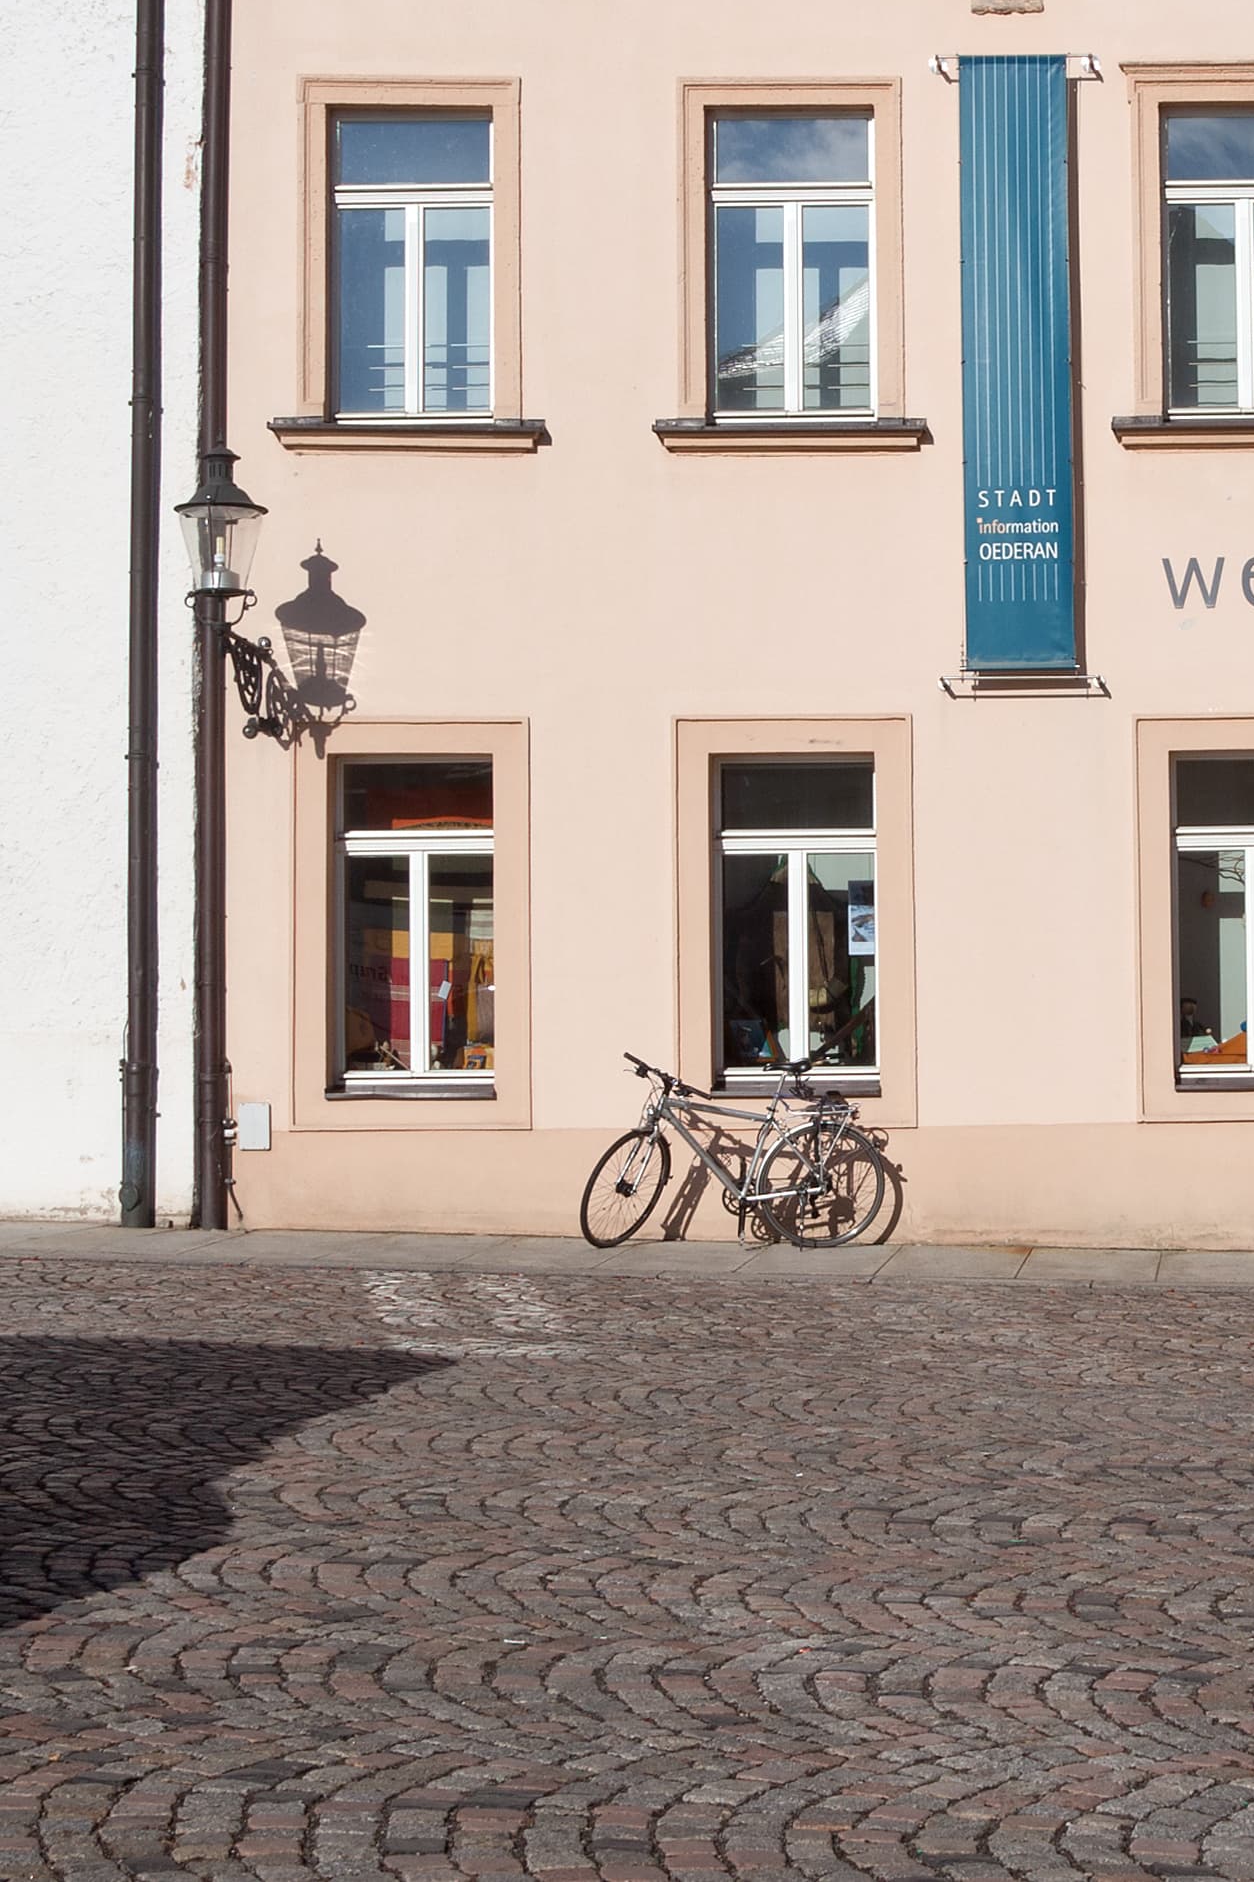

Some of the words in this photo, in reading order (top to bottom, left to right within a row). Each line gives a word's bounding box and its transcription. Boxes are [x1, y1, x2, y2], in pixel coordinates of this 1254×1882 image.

[978, 489, 1057, 507] STADT
[976, 517, 1059, 535] information
[979, 542, 1058, 560] OEDERAN
